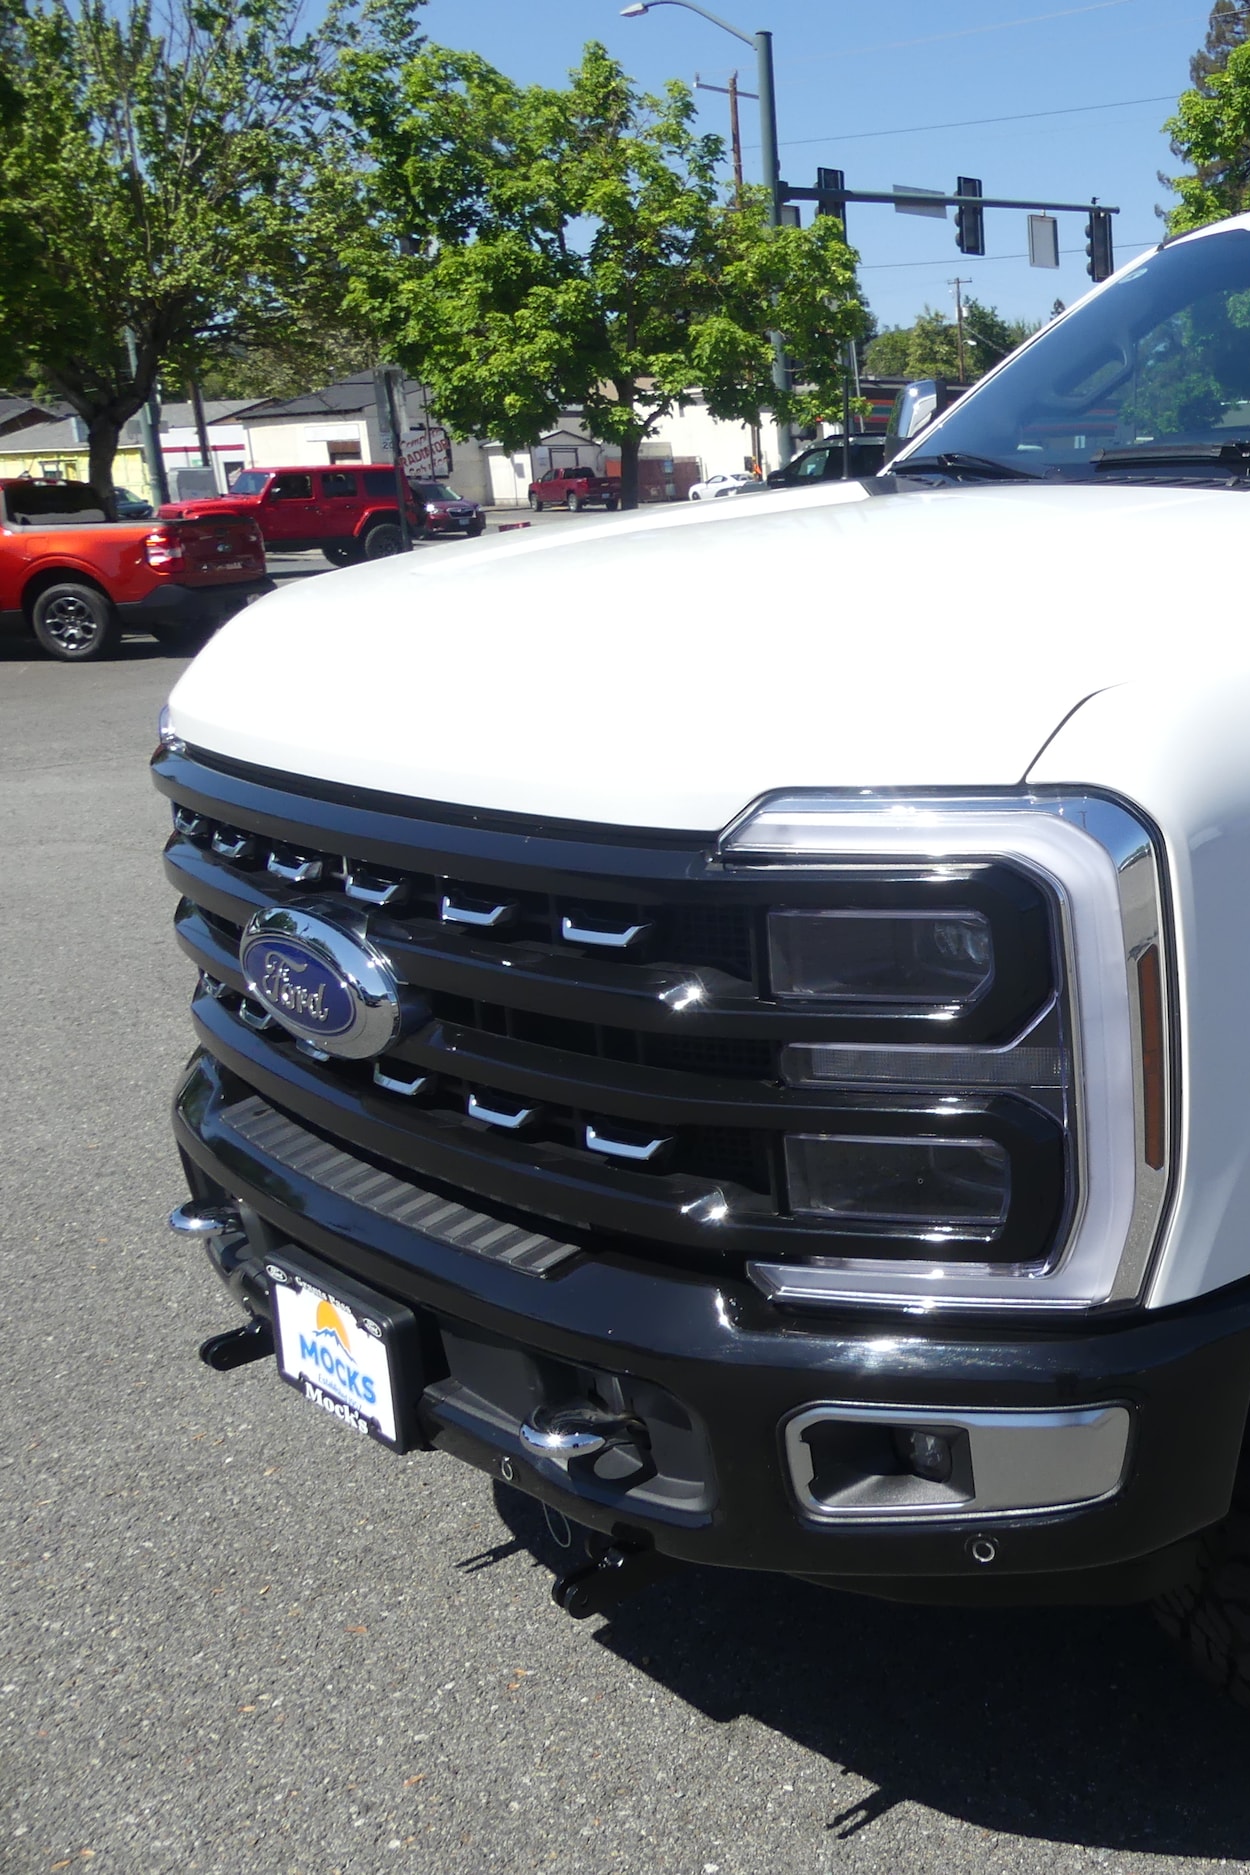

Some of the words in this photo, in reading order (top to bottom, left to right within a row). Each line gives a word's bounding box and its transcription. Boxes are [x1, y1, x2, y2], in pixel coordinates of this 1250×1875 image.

[262, 951, 329, 1022] Ford
[299, 1333, 377, 1404] MOCKS
[305, 1381, 369, 1435] Mock's
